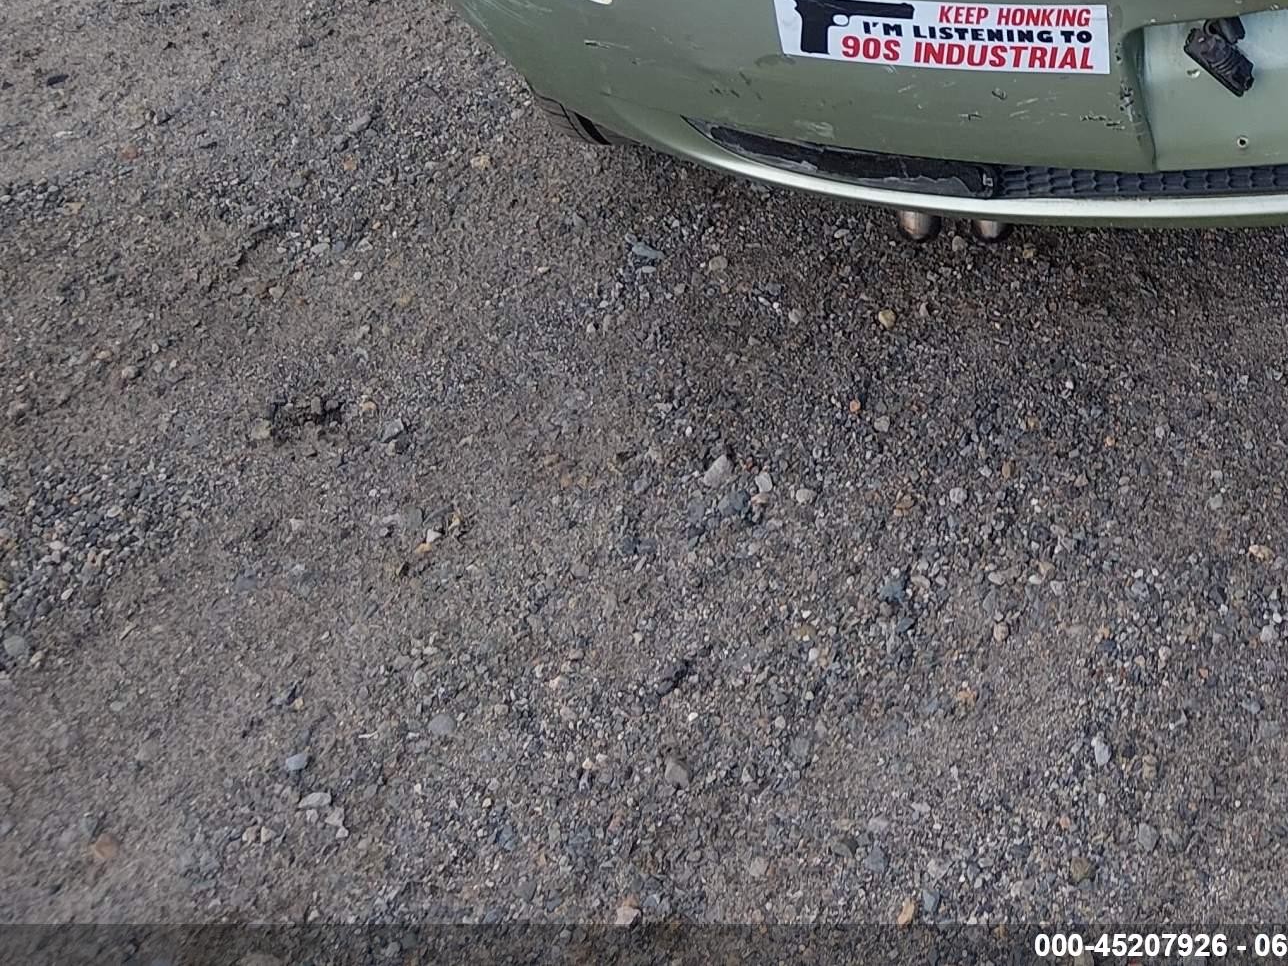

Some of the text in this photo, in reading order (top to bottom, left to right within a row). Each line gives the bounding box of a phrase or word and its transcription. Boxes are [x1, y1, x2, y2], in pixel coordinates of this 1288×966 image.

[939, 5, 1091, 27] KEEP HONKING
[863, 20, 1093, 44] I'M LISTENING TO
[841, 36, 1094, 70] 90S INDUSTRIAL
